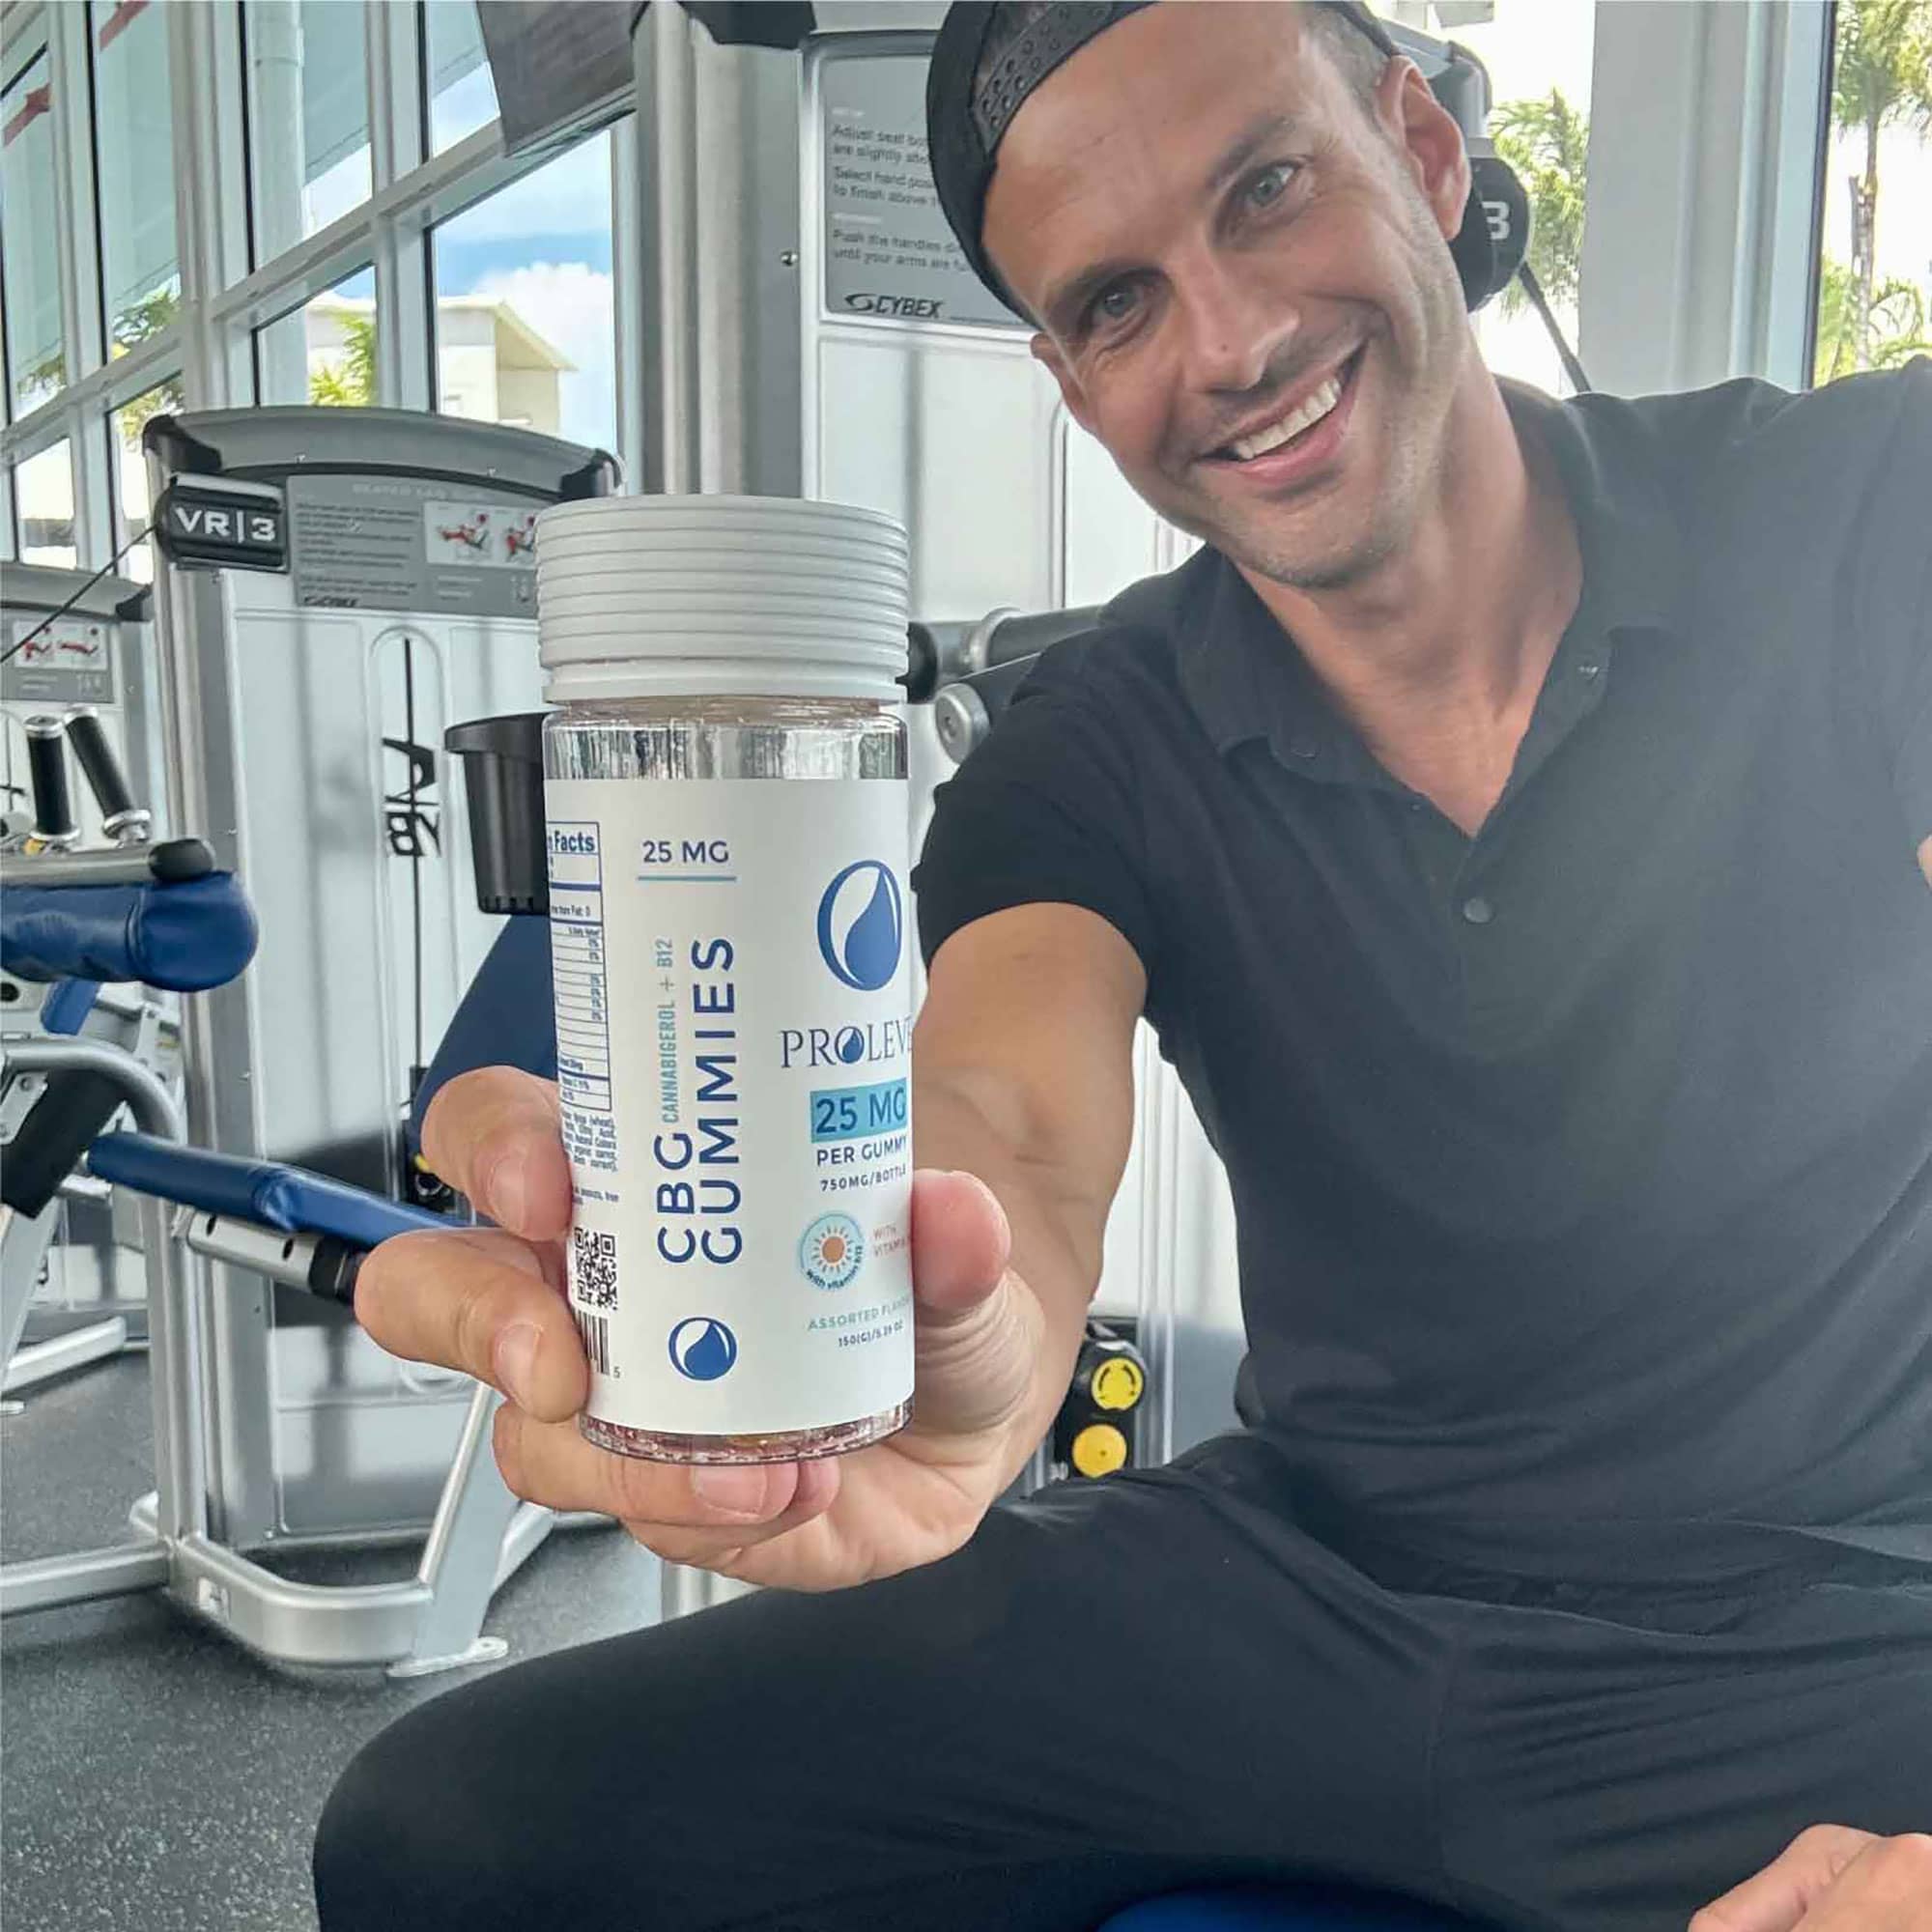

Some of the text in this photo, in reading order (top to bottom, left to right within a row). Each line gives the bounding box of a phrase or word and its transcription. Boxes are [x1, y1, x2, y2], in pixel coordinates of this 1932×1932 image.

[865, 253, 892, 265] your
[875, 295, 946, 319] CYBEX
[554, 831, 595, 852] Facts
[642, 839, 729, 864] 25 MG
[657, 938, 672, 967] B12
[658, 1000, 680, 1123] CANNABIGEROL
[691, 938, 743, 1264] GUMMIES
[815, 1086, 907, 1135] 25 MG
[816, 1145, 855, 1167] PER
[654, 1132, 696, 1264] CBG
[808, 1306, 879, 1331] ASSORTED
